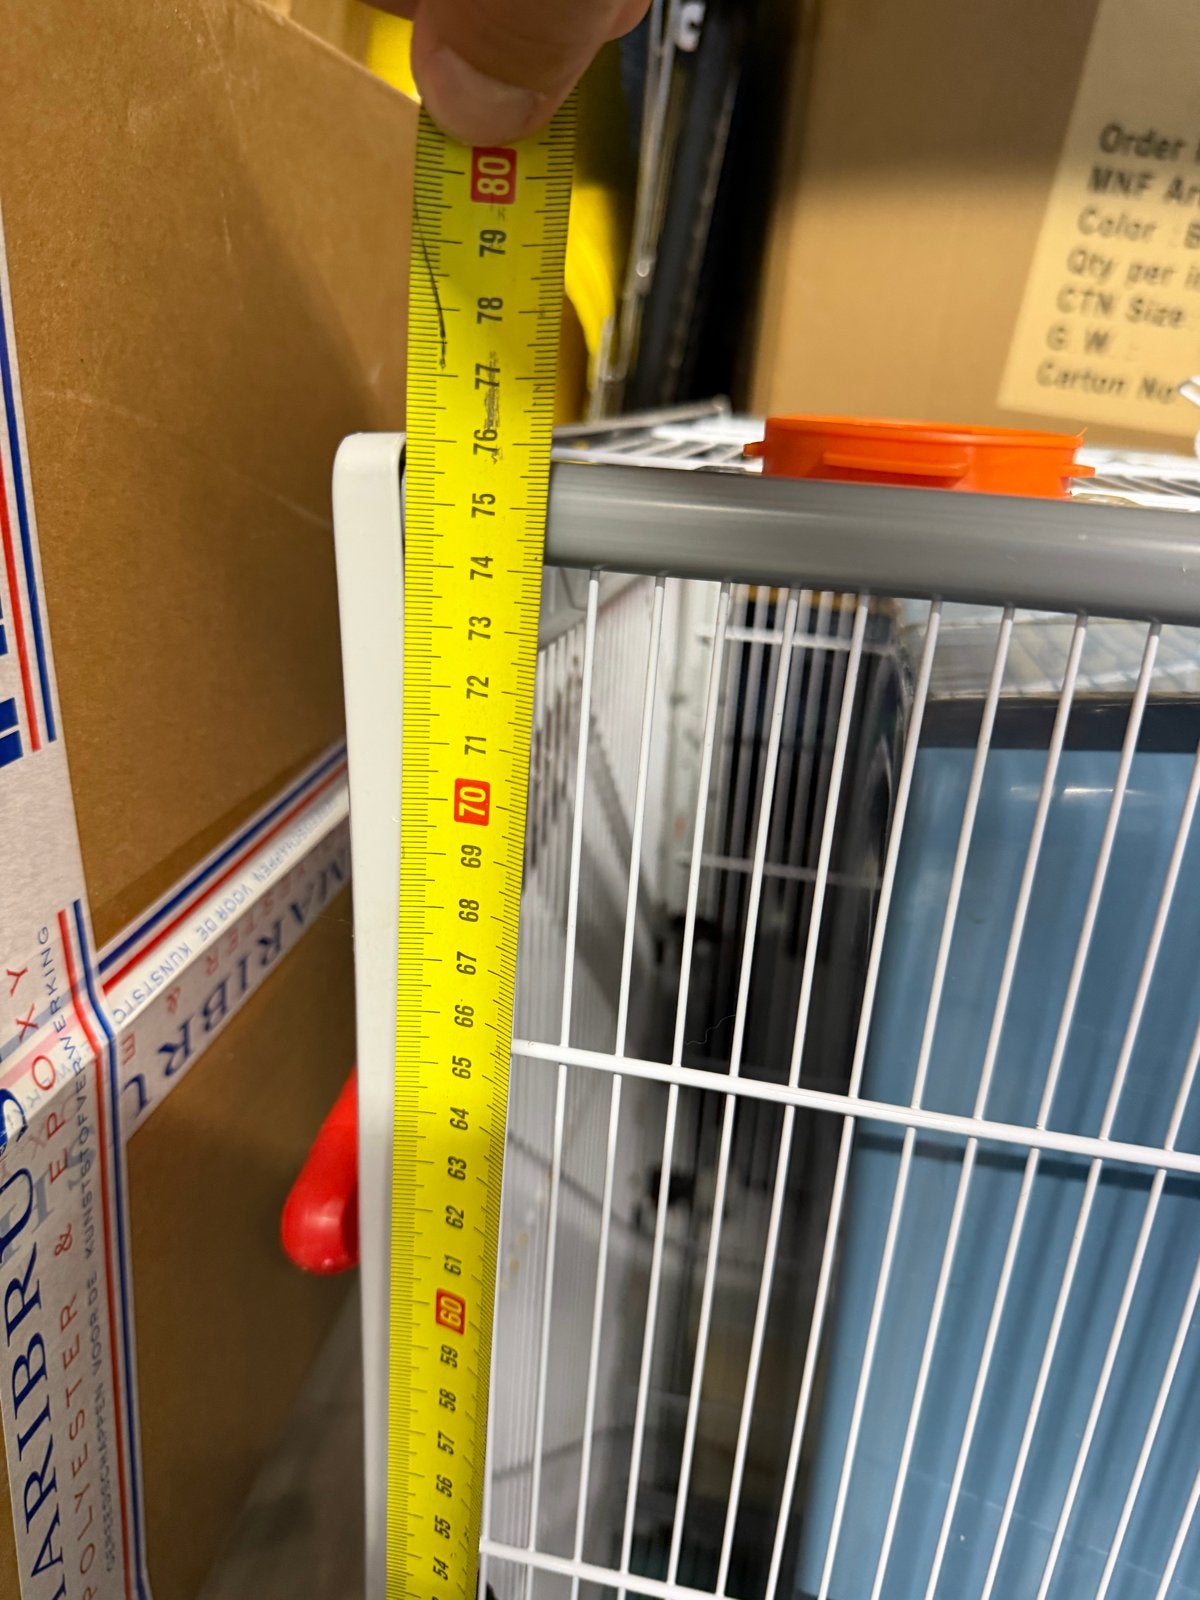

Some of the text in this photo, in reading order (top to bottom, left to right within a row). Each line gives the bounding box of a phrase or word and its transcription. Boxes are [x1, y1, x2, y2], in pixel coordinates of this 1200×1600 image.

[1100, 122, 1184, 161] Order
[1078, 205, 1156, 241] Color
[1066, 246, 1113, 282] Qty
[1124, 261, 1174, 288] per
[1056, 284, 1184, 328] CTN Size
[1036, 360, 1125, 395] Carton
[432, 157, 511, 1581] 54 55 56 57 58 59 60 61 62 63 64 65 66 67 68 69 70 71 72 73 74 75 76 77 78 79 80
[217, 884, 252, 923] VOOR
[196, 918, 218, 942] DE
[6, 966, 68, 1184] EPOXY
[37, 926, 96, 1259] KUNSTSTOFVERWERKING
[54, 1223, 73, 1256] &
[86, 1270, 98, 1307] DE
[89, 1309, 102, 1375] VOOR
